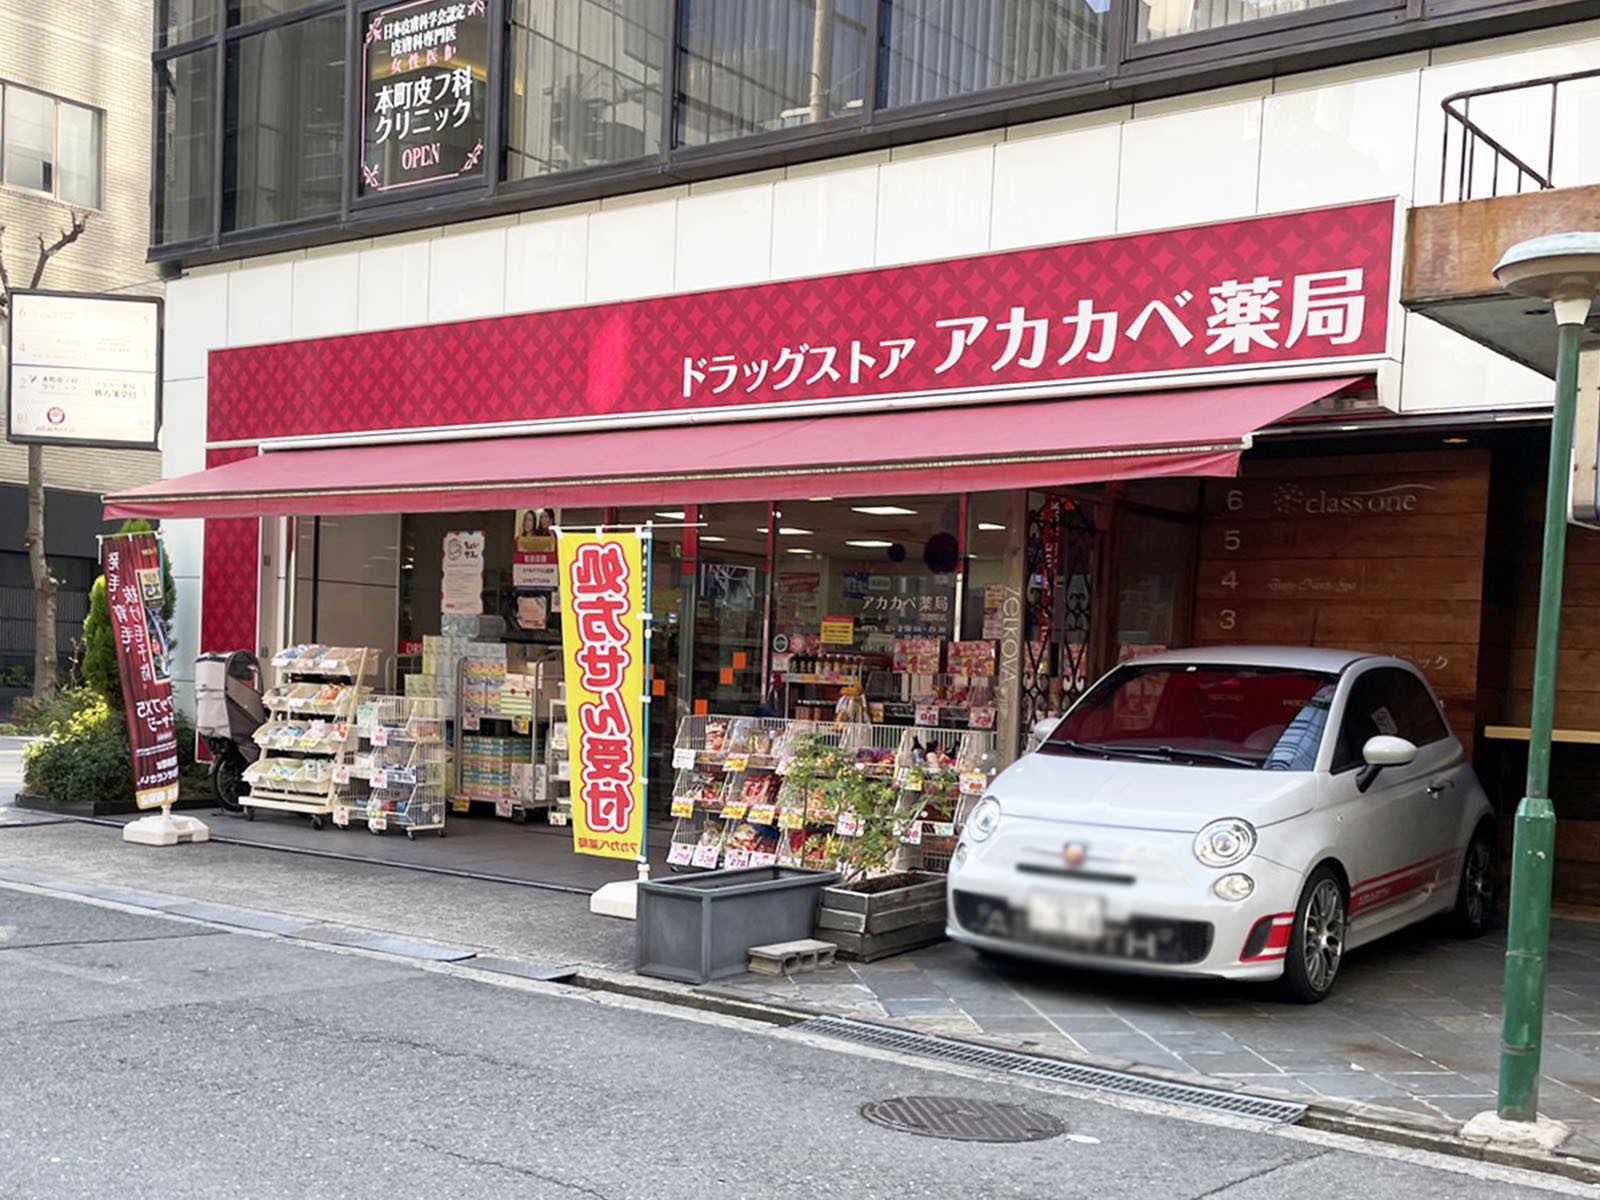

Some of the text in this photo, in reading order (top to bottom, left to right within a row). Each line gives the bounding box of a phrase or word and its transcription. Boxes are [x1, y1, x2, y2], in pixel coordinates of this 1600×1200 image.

[374, 65, 473, 114] 本町皮フ科
[375, 98, 472, 144] クリニック
[401, 143, 441, 170] OPEN
[682, 268, 1365, 397] ドラッグストア アカカベ薬局
[1227, 489, 1244, 511] 6
[1223, 529, 1241, 551] 5
[1220, 570, 1239, 590] 4
[862, 595, 949, 612] アカカベ薬局
[1219, 609, 1236, 630] 3
